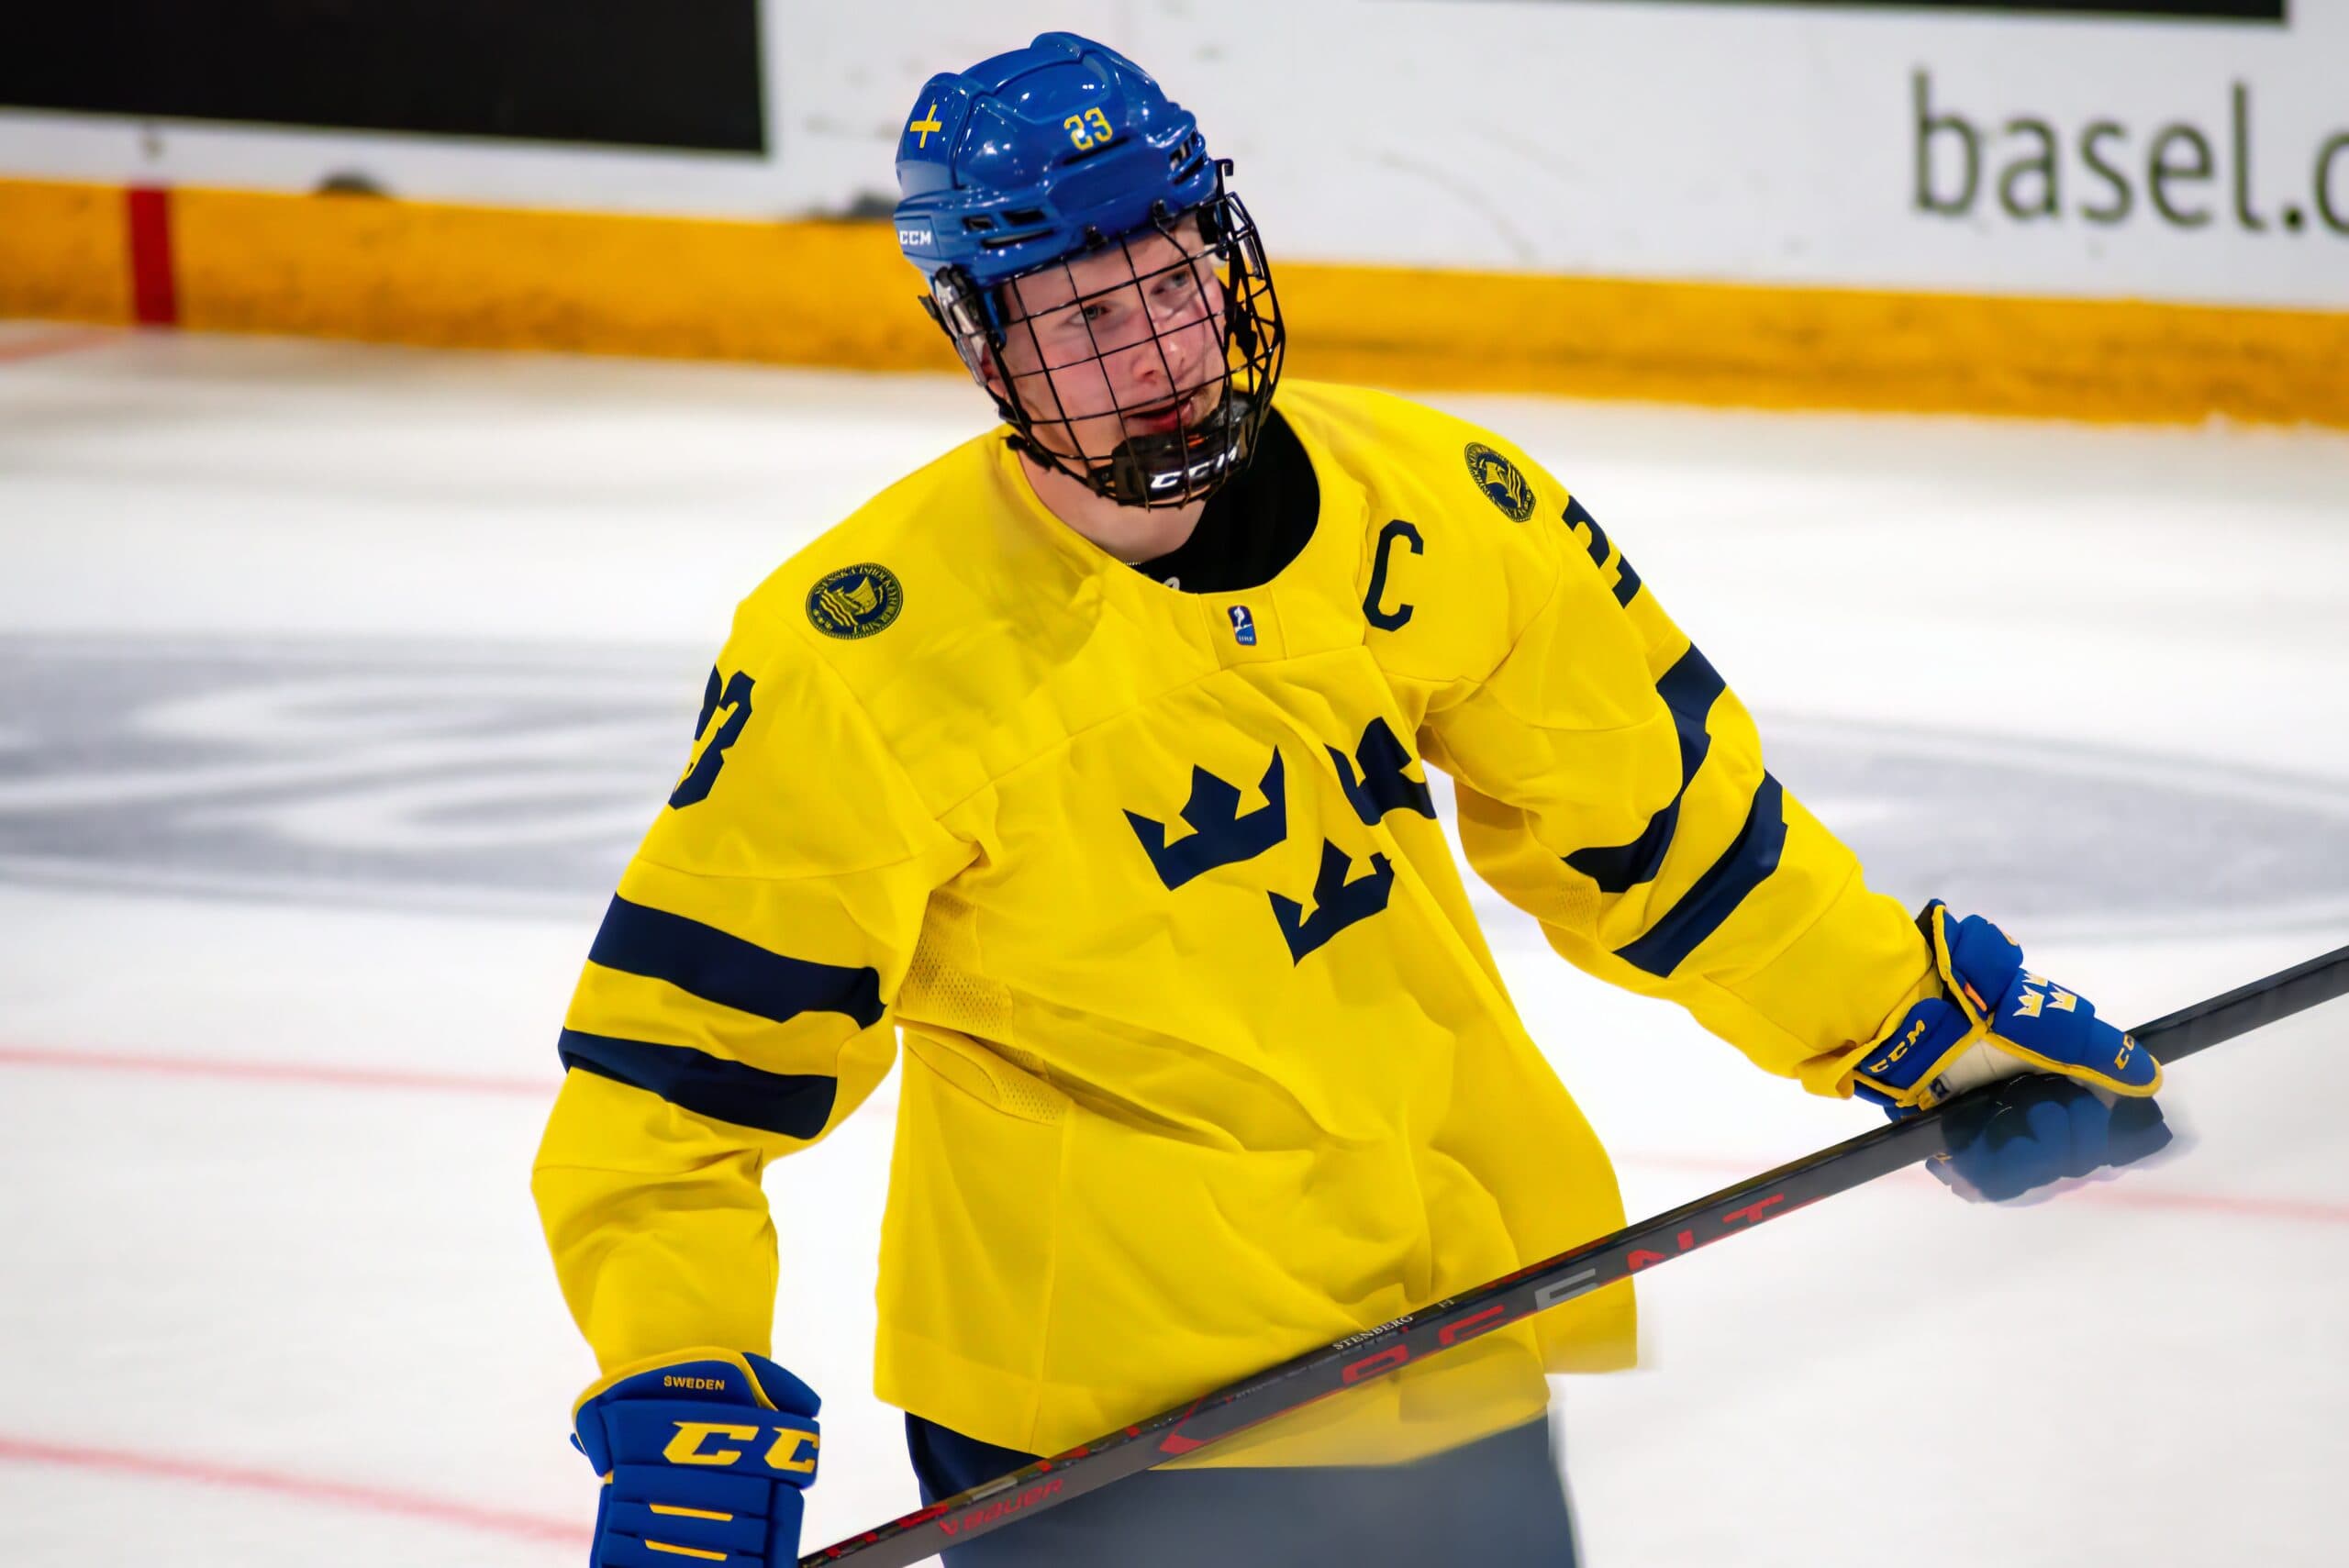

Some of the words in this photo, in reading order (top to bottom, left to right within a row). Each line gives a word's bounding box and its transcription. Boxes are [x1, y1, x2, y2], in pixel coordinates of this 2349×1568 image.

[1063, 106, 1113, 151] 23
[899, 230, 931, 246] CCM
[1362, 518, 1424, 632] C
[1331, 1314, 1414, 1351] STENBERG
[662, 1374, 726, 1391] SWEDEN
